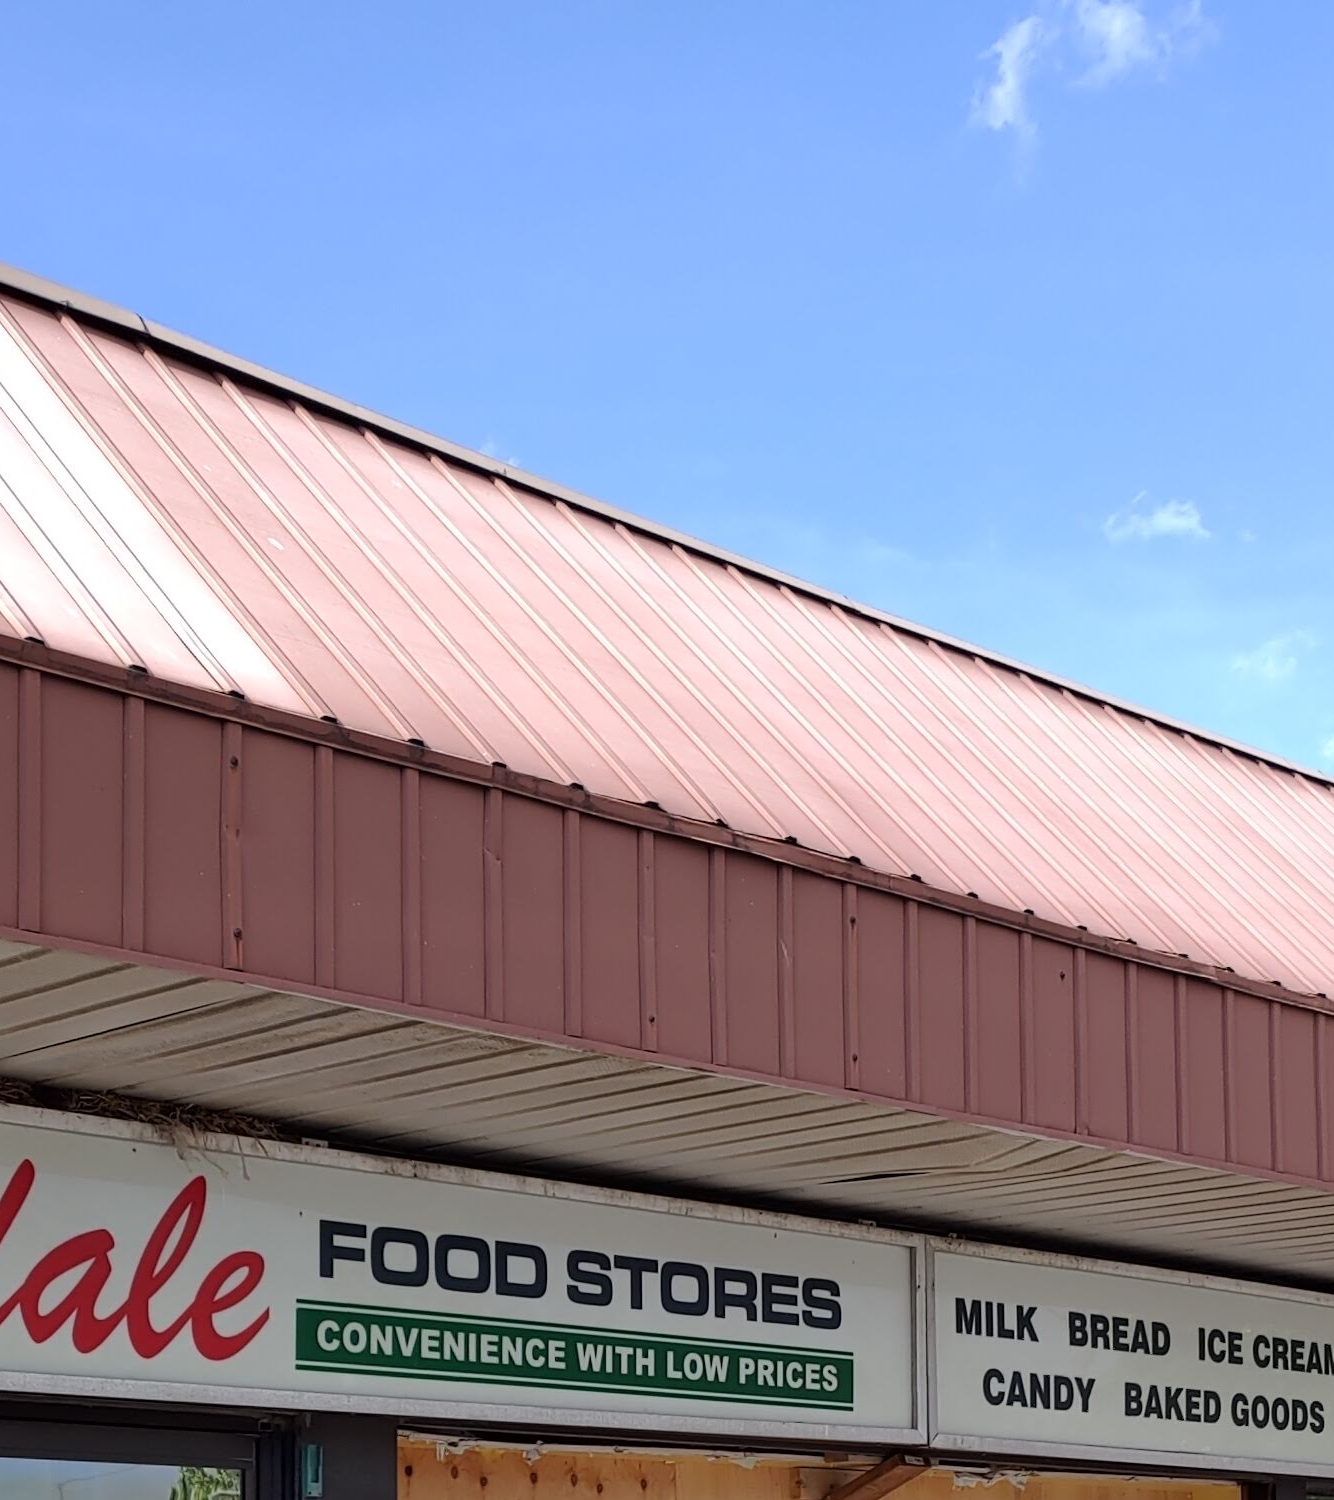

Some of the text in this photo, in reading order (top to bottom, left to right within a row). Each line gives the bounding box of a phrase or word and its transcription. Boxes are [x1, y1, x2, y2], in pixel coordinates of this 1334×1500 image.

[318, 1219, 843, 1331] FOOD STORES
[316, 1319, 839, 1393] CONVENIENCE WITH LOW PRICES
[955, 1298, 1039, 1342] MILK
[1069, 1311, 1171, 1356] BREAD
[1198, 1327, 1244, 1365] ICE
[983, 1368, 1325, 1435] CANDY BAKED GOODS
